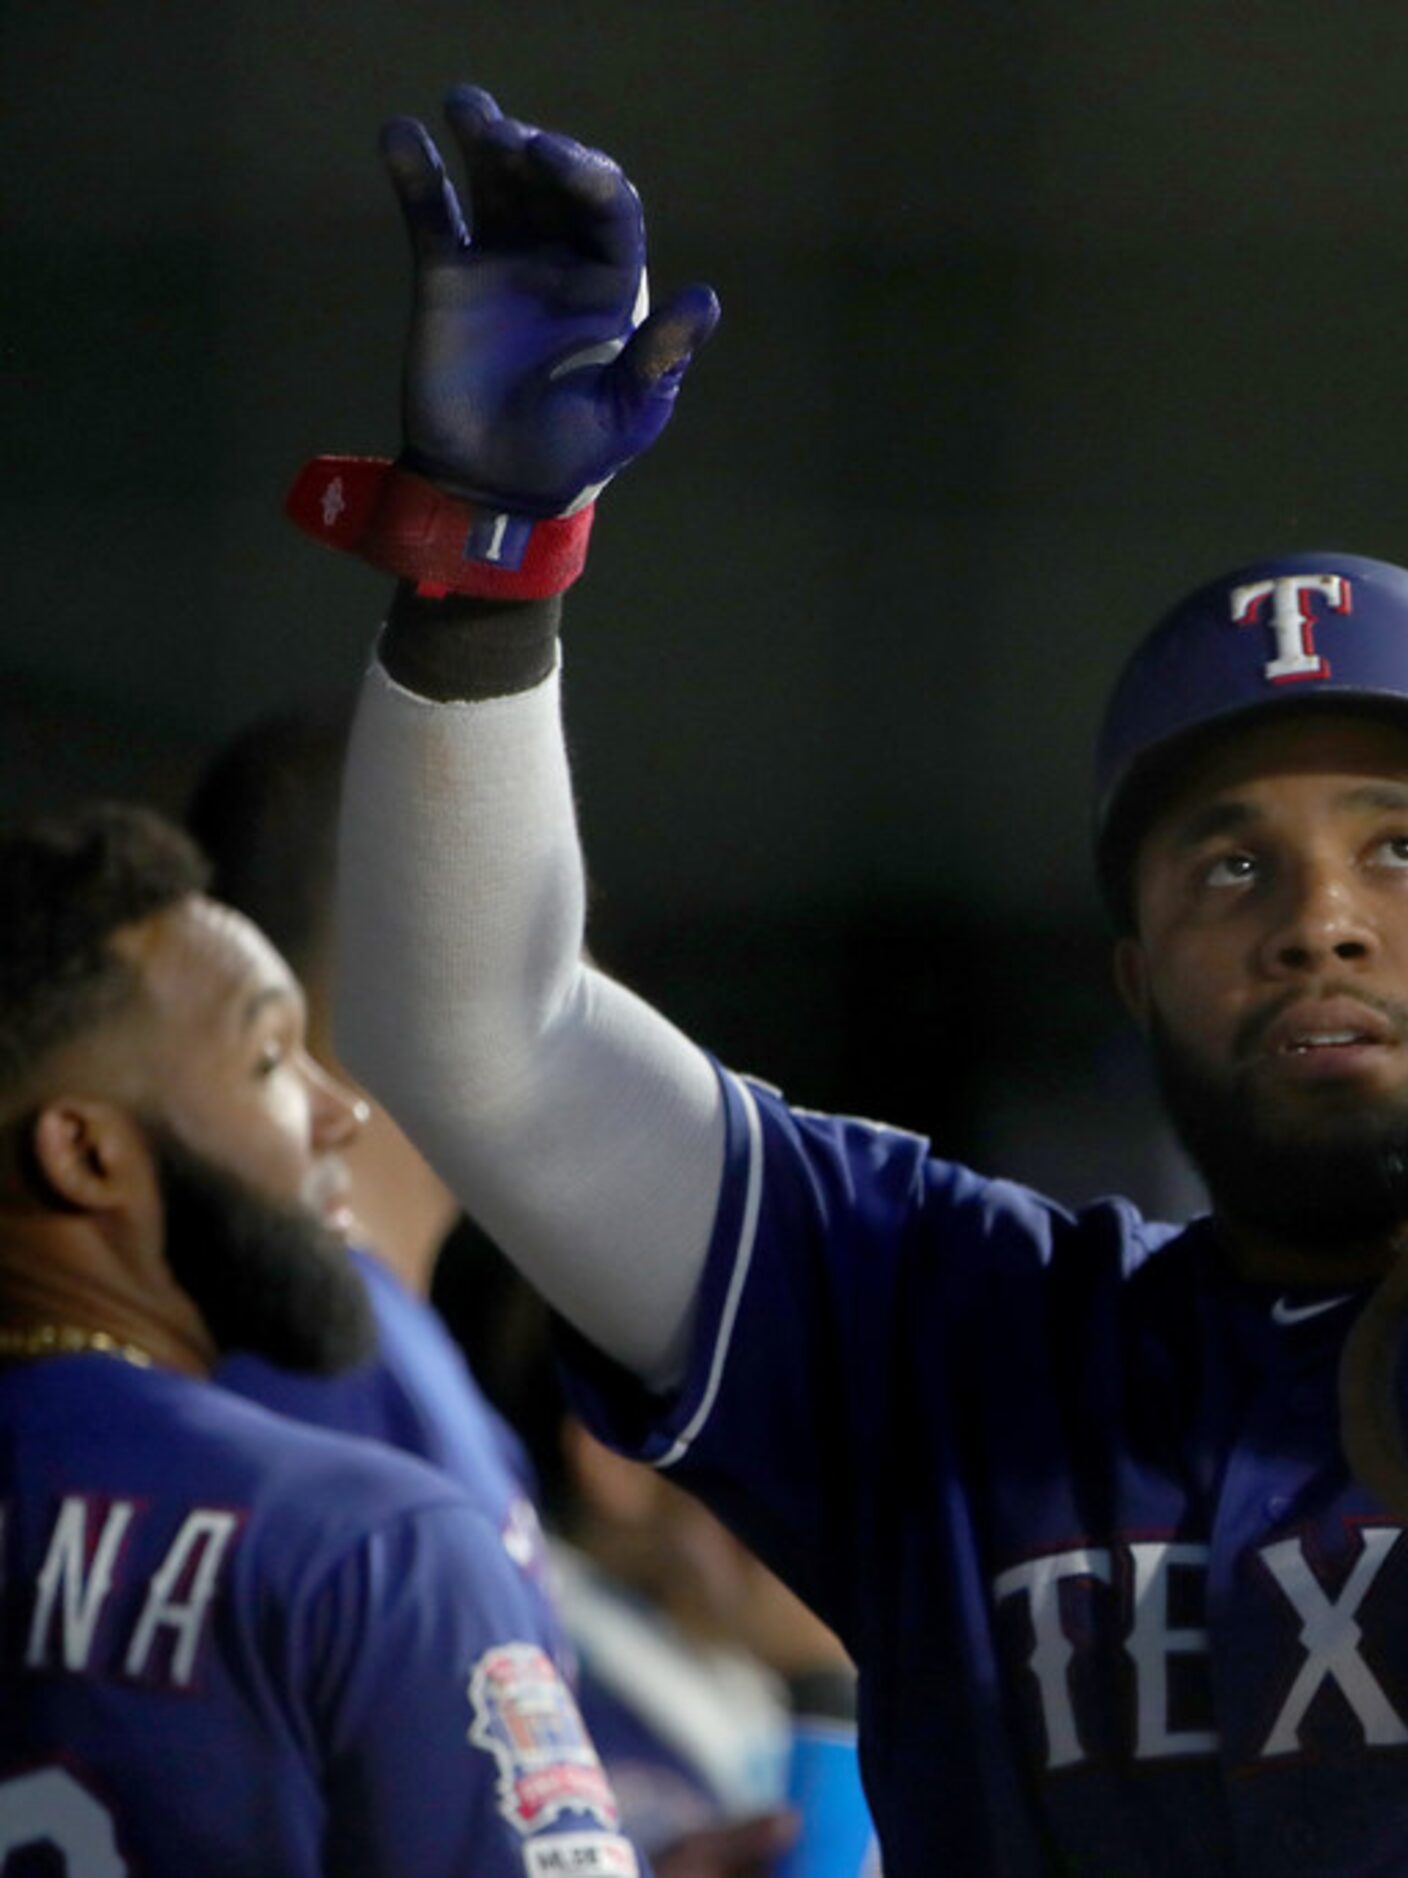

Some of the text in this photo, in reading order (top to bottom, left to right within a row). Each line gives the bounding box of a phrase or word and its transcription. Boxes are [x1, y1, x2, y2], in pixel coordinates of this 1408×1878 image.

[485, 513, 510, 562] 1
[1230, 573, 1353, 686] T
[0, 1494, 240, 1690] NA
